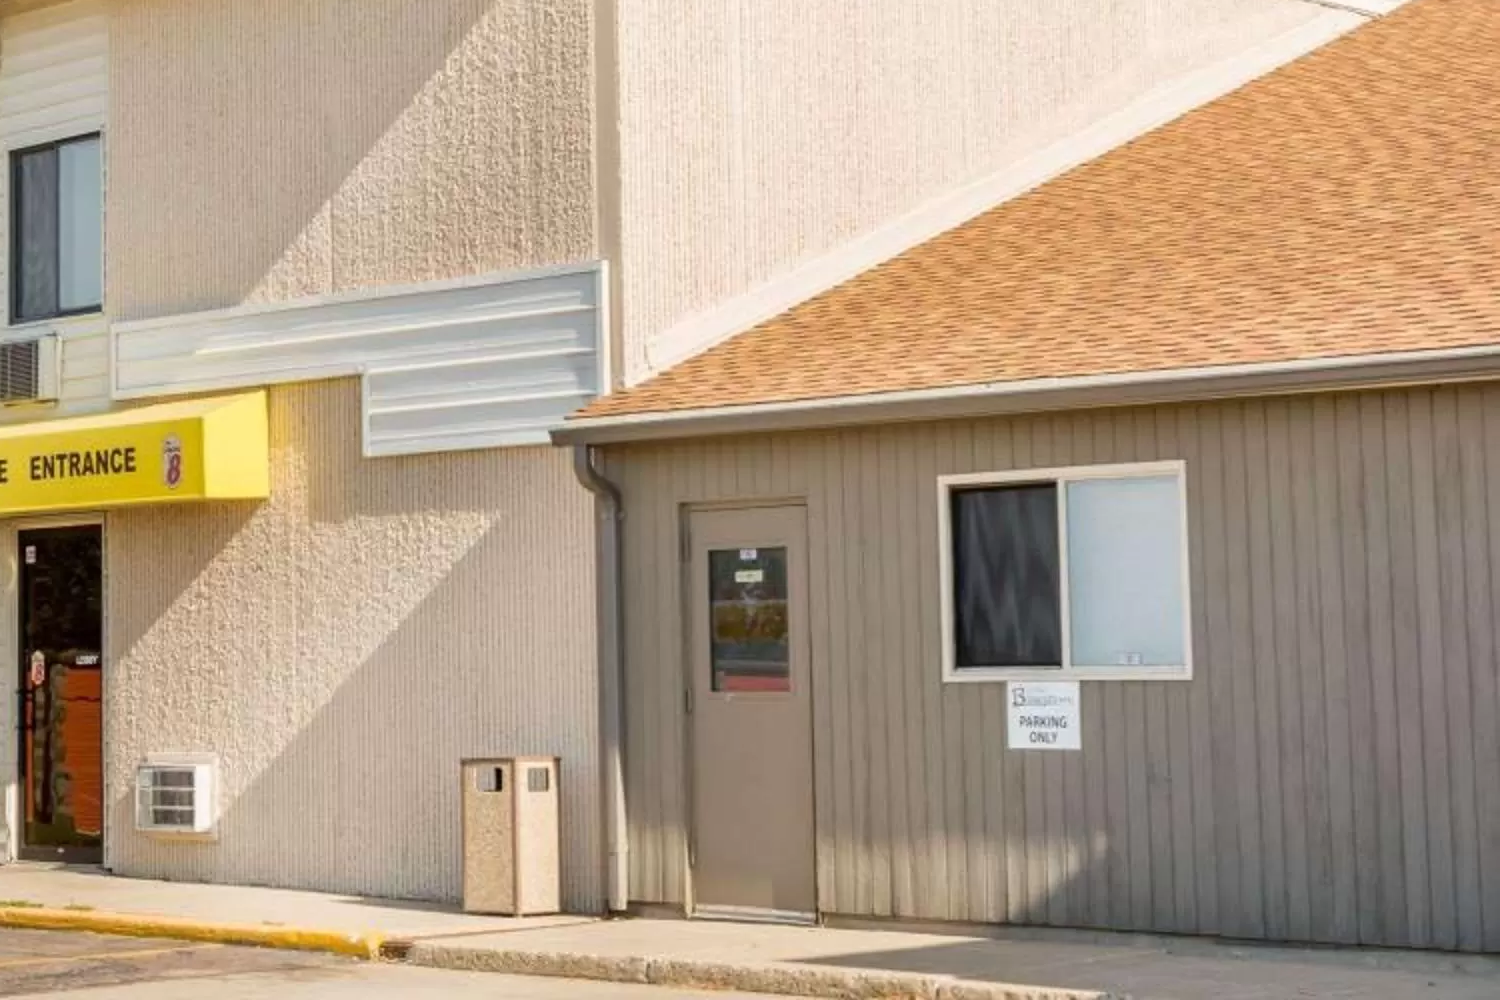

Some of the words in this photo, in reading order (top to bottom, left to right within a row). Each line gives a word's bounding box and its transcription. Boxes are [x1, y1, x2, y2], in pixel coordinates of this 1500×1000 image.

[30, 447, 136, 480] ENTRANCE
[1019, 715, 1067, 728] PARKING
[1029, 731, 1058, 743] ONLY
